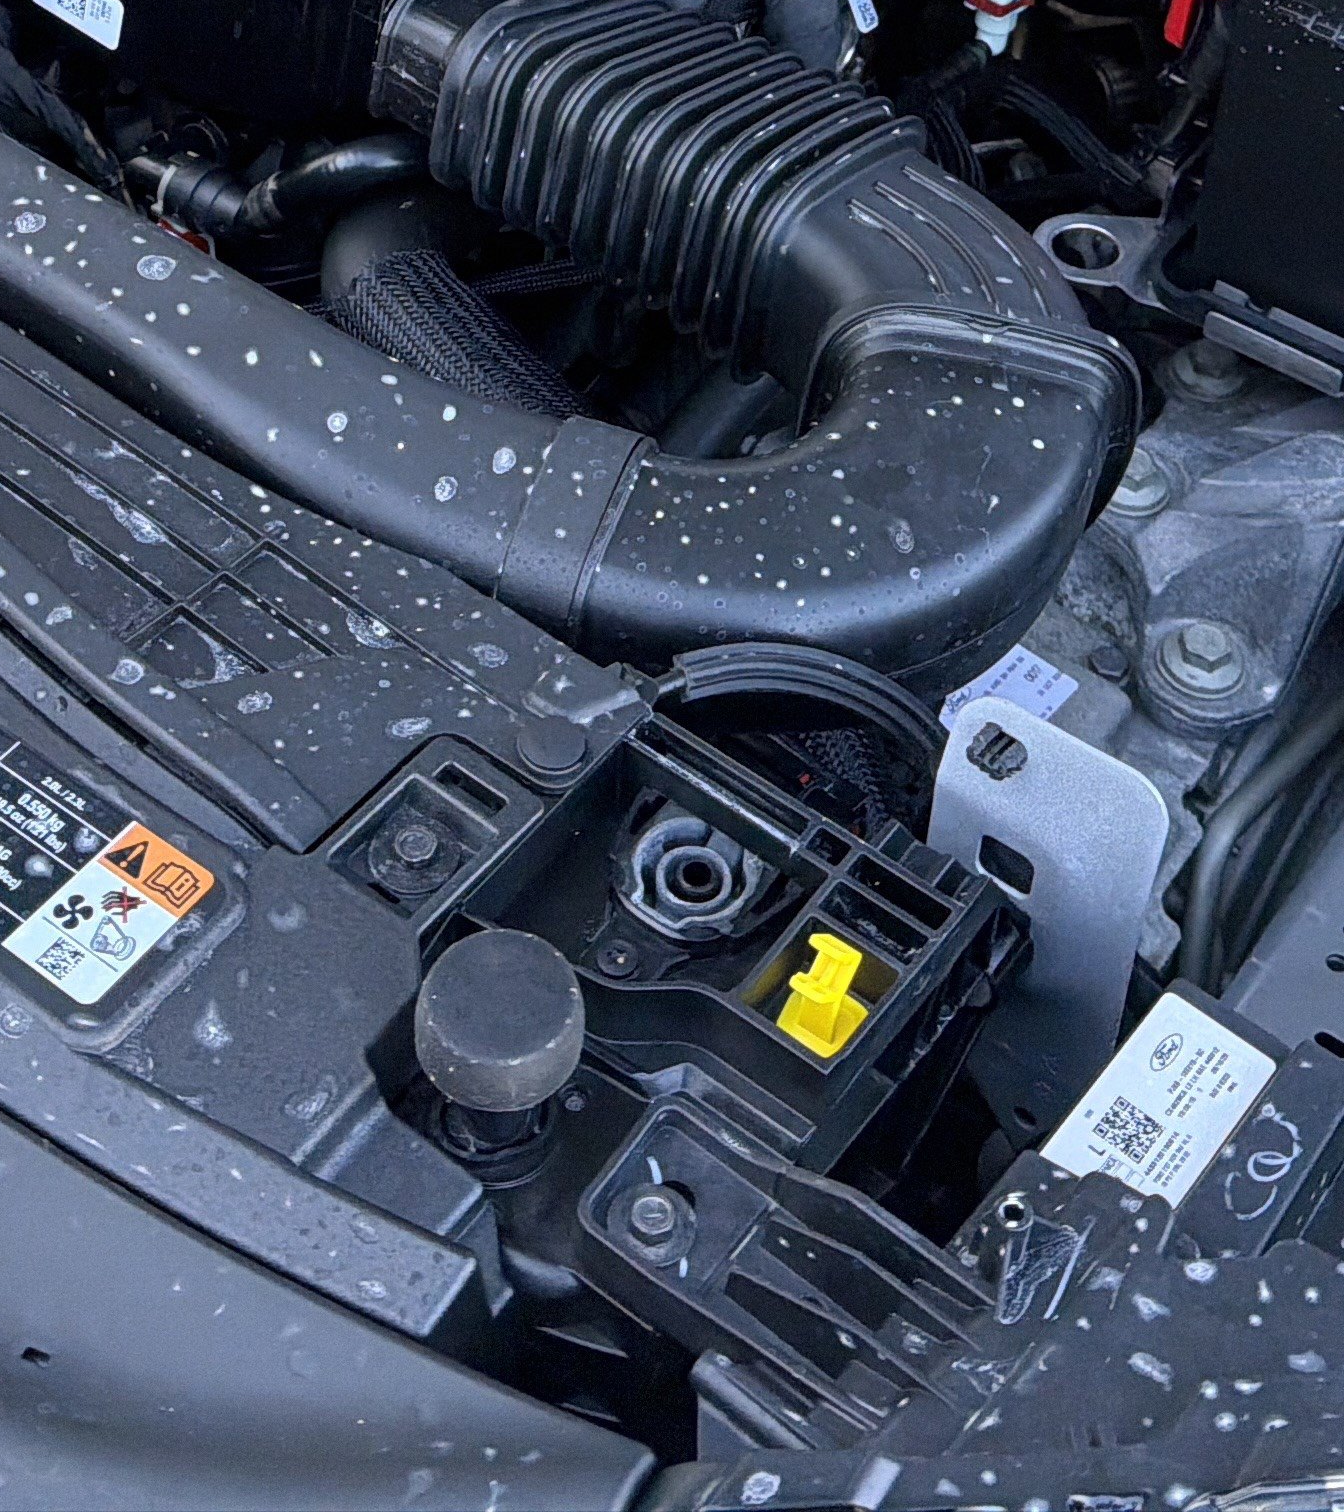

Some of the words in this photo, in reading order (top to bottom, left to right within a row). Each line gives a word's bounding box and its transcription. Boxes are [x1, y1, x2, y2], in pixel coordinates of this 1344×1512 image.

[40, 776, 63, 792] 2.0L
[64, 792, 87, 809] 2.3L
[17, 794, 52, 819] 0.550
[43, 814, 67, 832] kg
[9, 811, 24, 823] oz
[42, 834, 67, 852] lbs)
[1153, 1036, 1180, 1069] Ford
